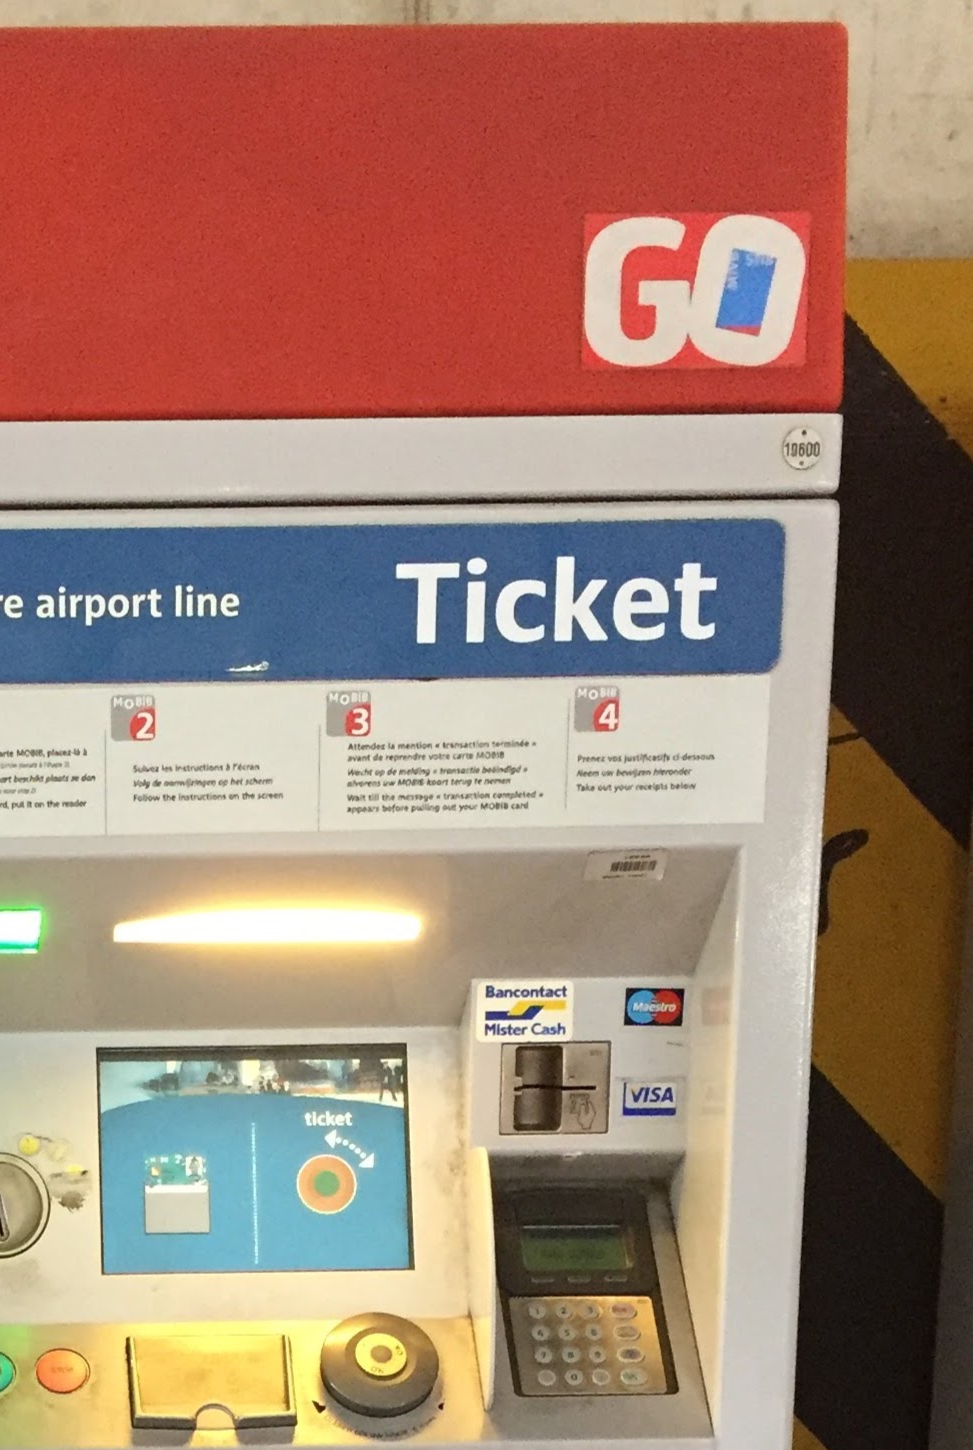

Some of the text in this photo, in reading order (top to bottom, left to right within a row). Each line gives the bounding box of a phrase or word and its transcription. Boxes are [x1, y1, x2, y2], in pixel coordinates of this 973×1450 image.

[585, 214, 805, 367] GO
[36, 585, 162, 627] airport
[175, 583, 241, 618] line
[396, 556, 718, 644] Ticket
[135, 712, 154, 739] 2
[351, 709, 369, 736] 3
[598, 703, 618, 730] 4
[485, 985, 567, 998] Bancontact
[633, 1002, 676, 1013] Maestro
[485, 1023, 566, 1036] Mister Cash
[631, 1087, 673, 1102] VISA
[305, 1112, 353, 1127] ticket
